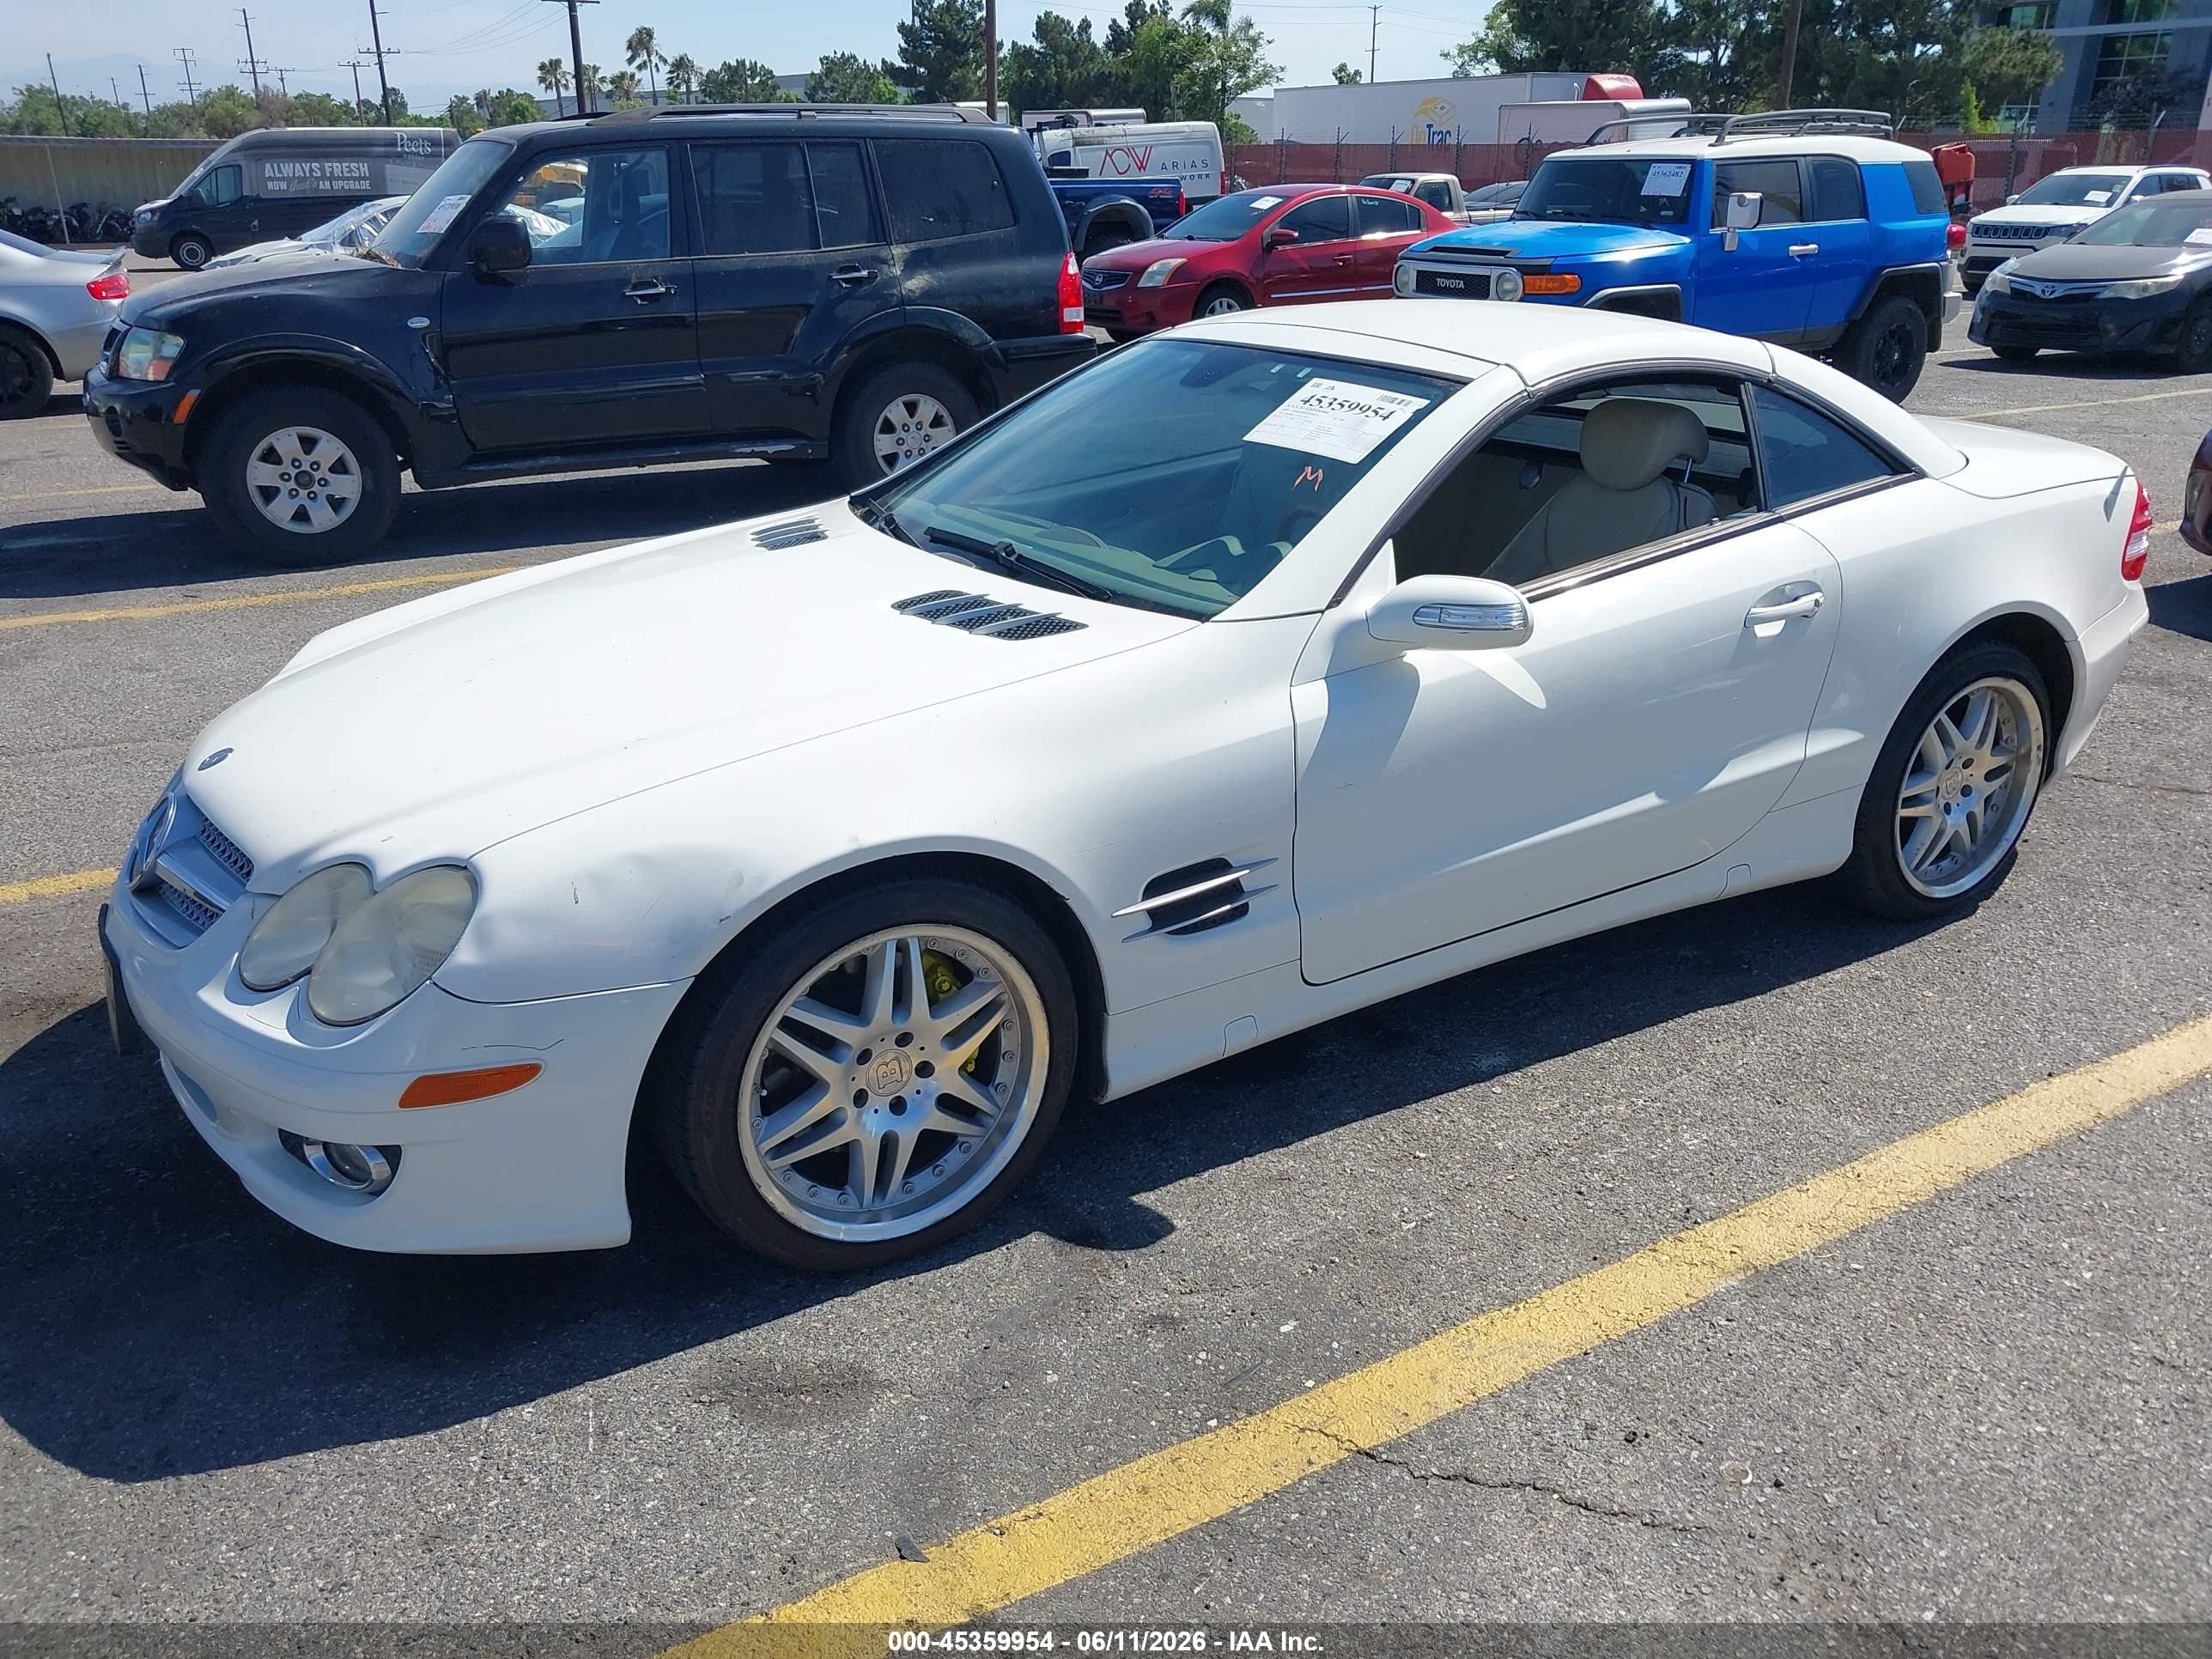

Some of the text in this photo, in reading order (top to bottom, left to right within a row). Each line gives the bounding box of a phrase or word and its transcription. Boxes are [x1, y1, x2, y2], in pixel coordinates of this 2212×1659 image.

[394, 131, 431, 155] Peet's
[264, 161, 370, 178] ALWAYS FRESH
[1160, 158, 1210, 172] ARIAS
[1181, 173, 1211, 182] WORK
[319, 179, 331, 191] AN
[332, 179, 372, 191] UPGRADE
[1436, 277, 1465, 289] TOYOTA
[1299, 393, 1396, 422] 45359954
